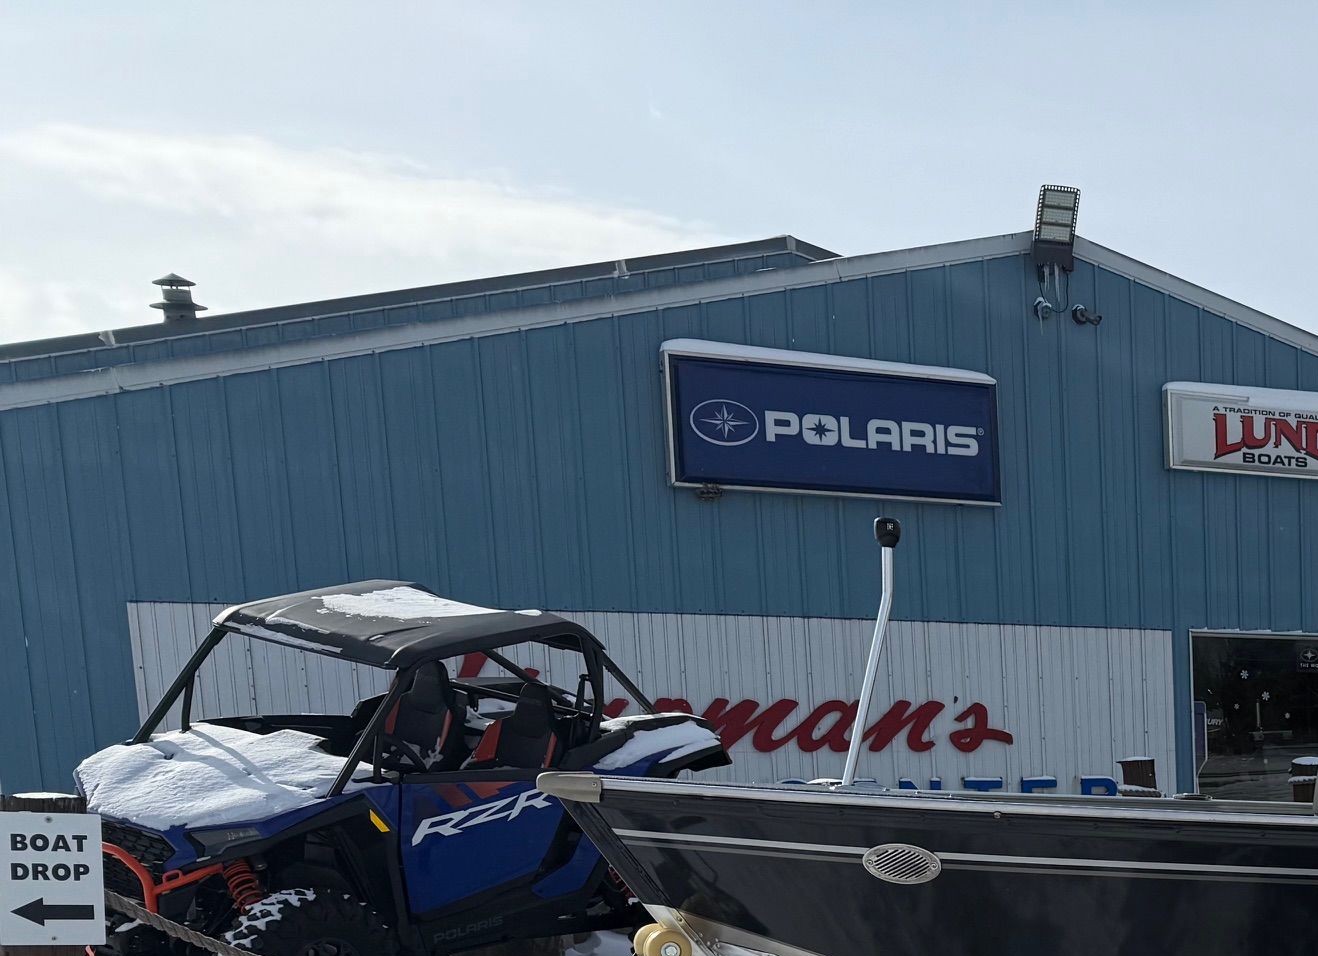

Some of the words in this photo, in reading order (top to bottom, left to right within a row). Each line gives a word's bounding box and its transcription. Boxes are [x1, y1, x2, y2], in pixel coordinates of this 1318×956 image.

[1223, 406, 1276, 417] TRADITION
[1242, 452, 1308, 468] BOATS
[411, 788, 553, 847] RZR
[10, 833, 88, 852] BOAT
[10, 863, 90, 881] DROP
[433, 915, 504, 944] POLARIS
